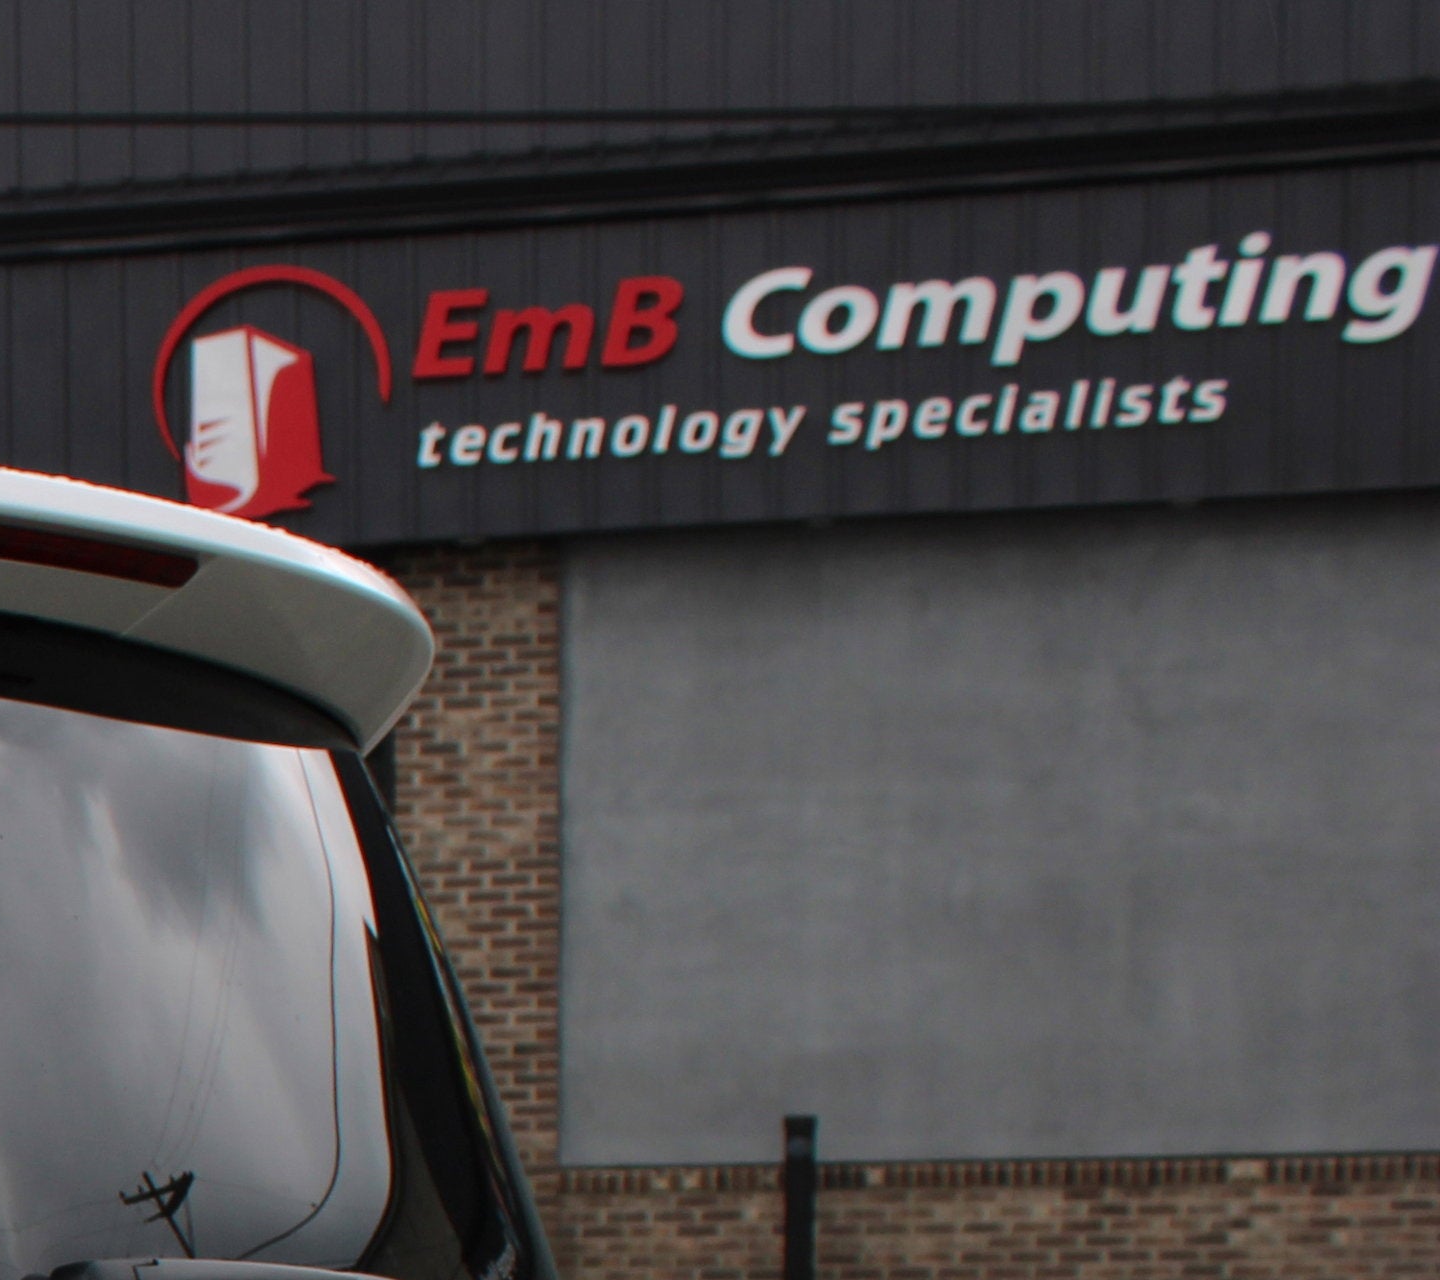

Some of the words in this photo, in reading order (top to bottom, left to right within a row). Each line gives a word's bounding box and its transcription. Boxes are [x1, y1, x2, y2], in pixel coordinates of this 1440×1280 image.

[411, 274, 683, 380] EmB
[721, 230, 1438, 367] Computing
[417, 404, 806, 469] technology
[827, 375, 1229, 451] specialists
